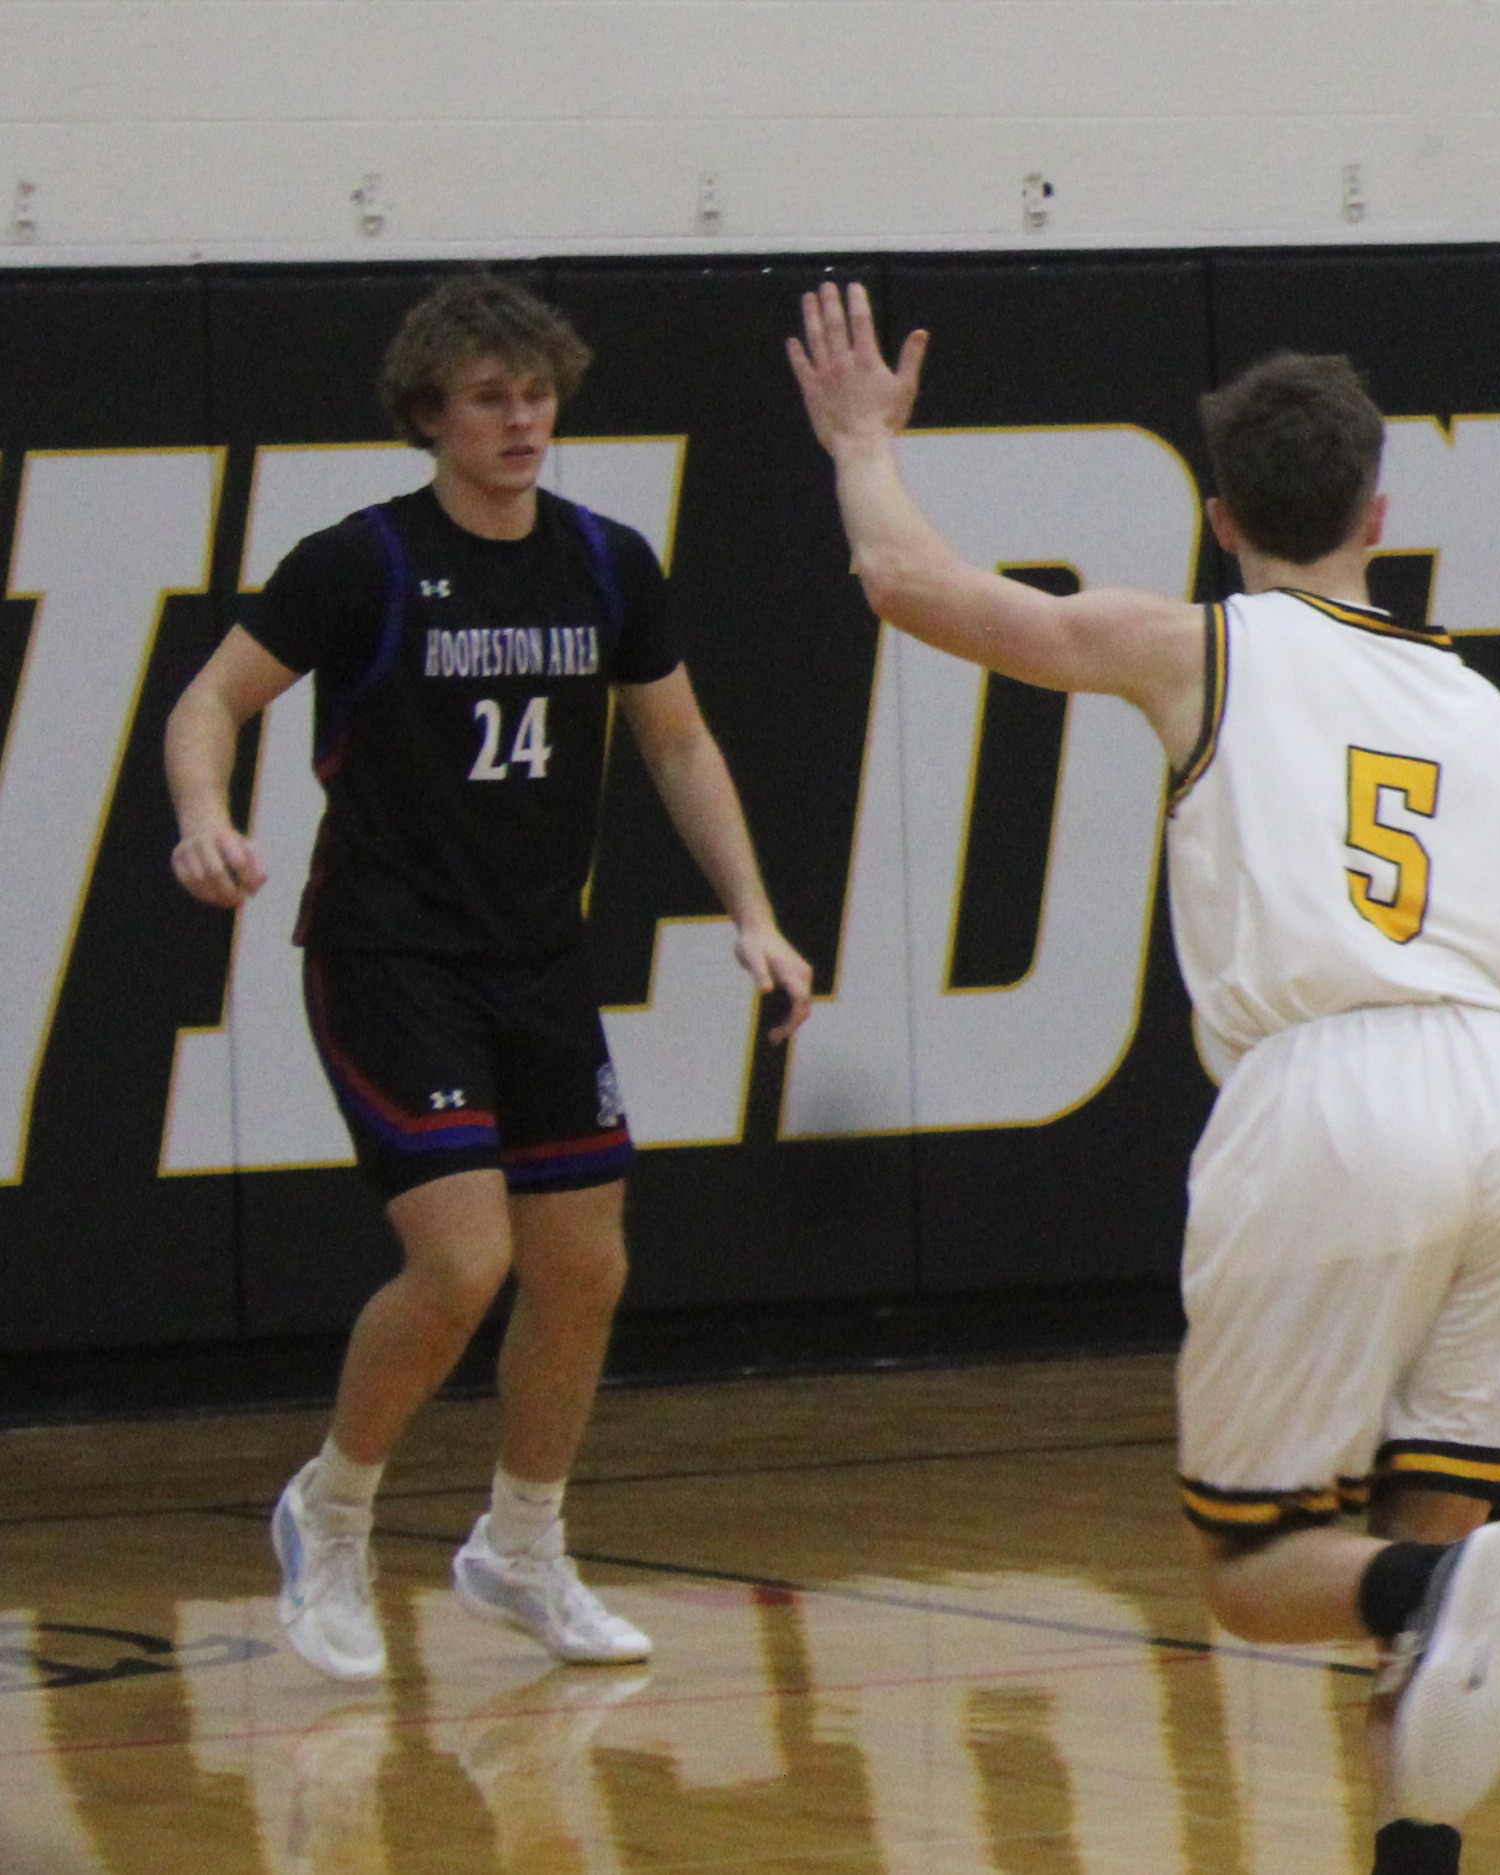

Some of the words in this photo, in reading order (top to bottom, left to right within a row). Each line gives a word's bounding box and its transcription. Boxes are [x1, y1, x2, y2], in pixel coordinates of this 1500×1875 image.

[425, 627, 544, 678] HOOPESTON
[547, 624, 599, 676] AREA
[467, 696, 554, 781] 24
[1343, 743, 1442, 945] 5
